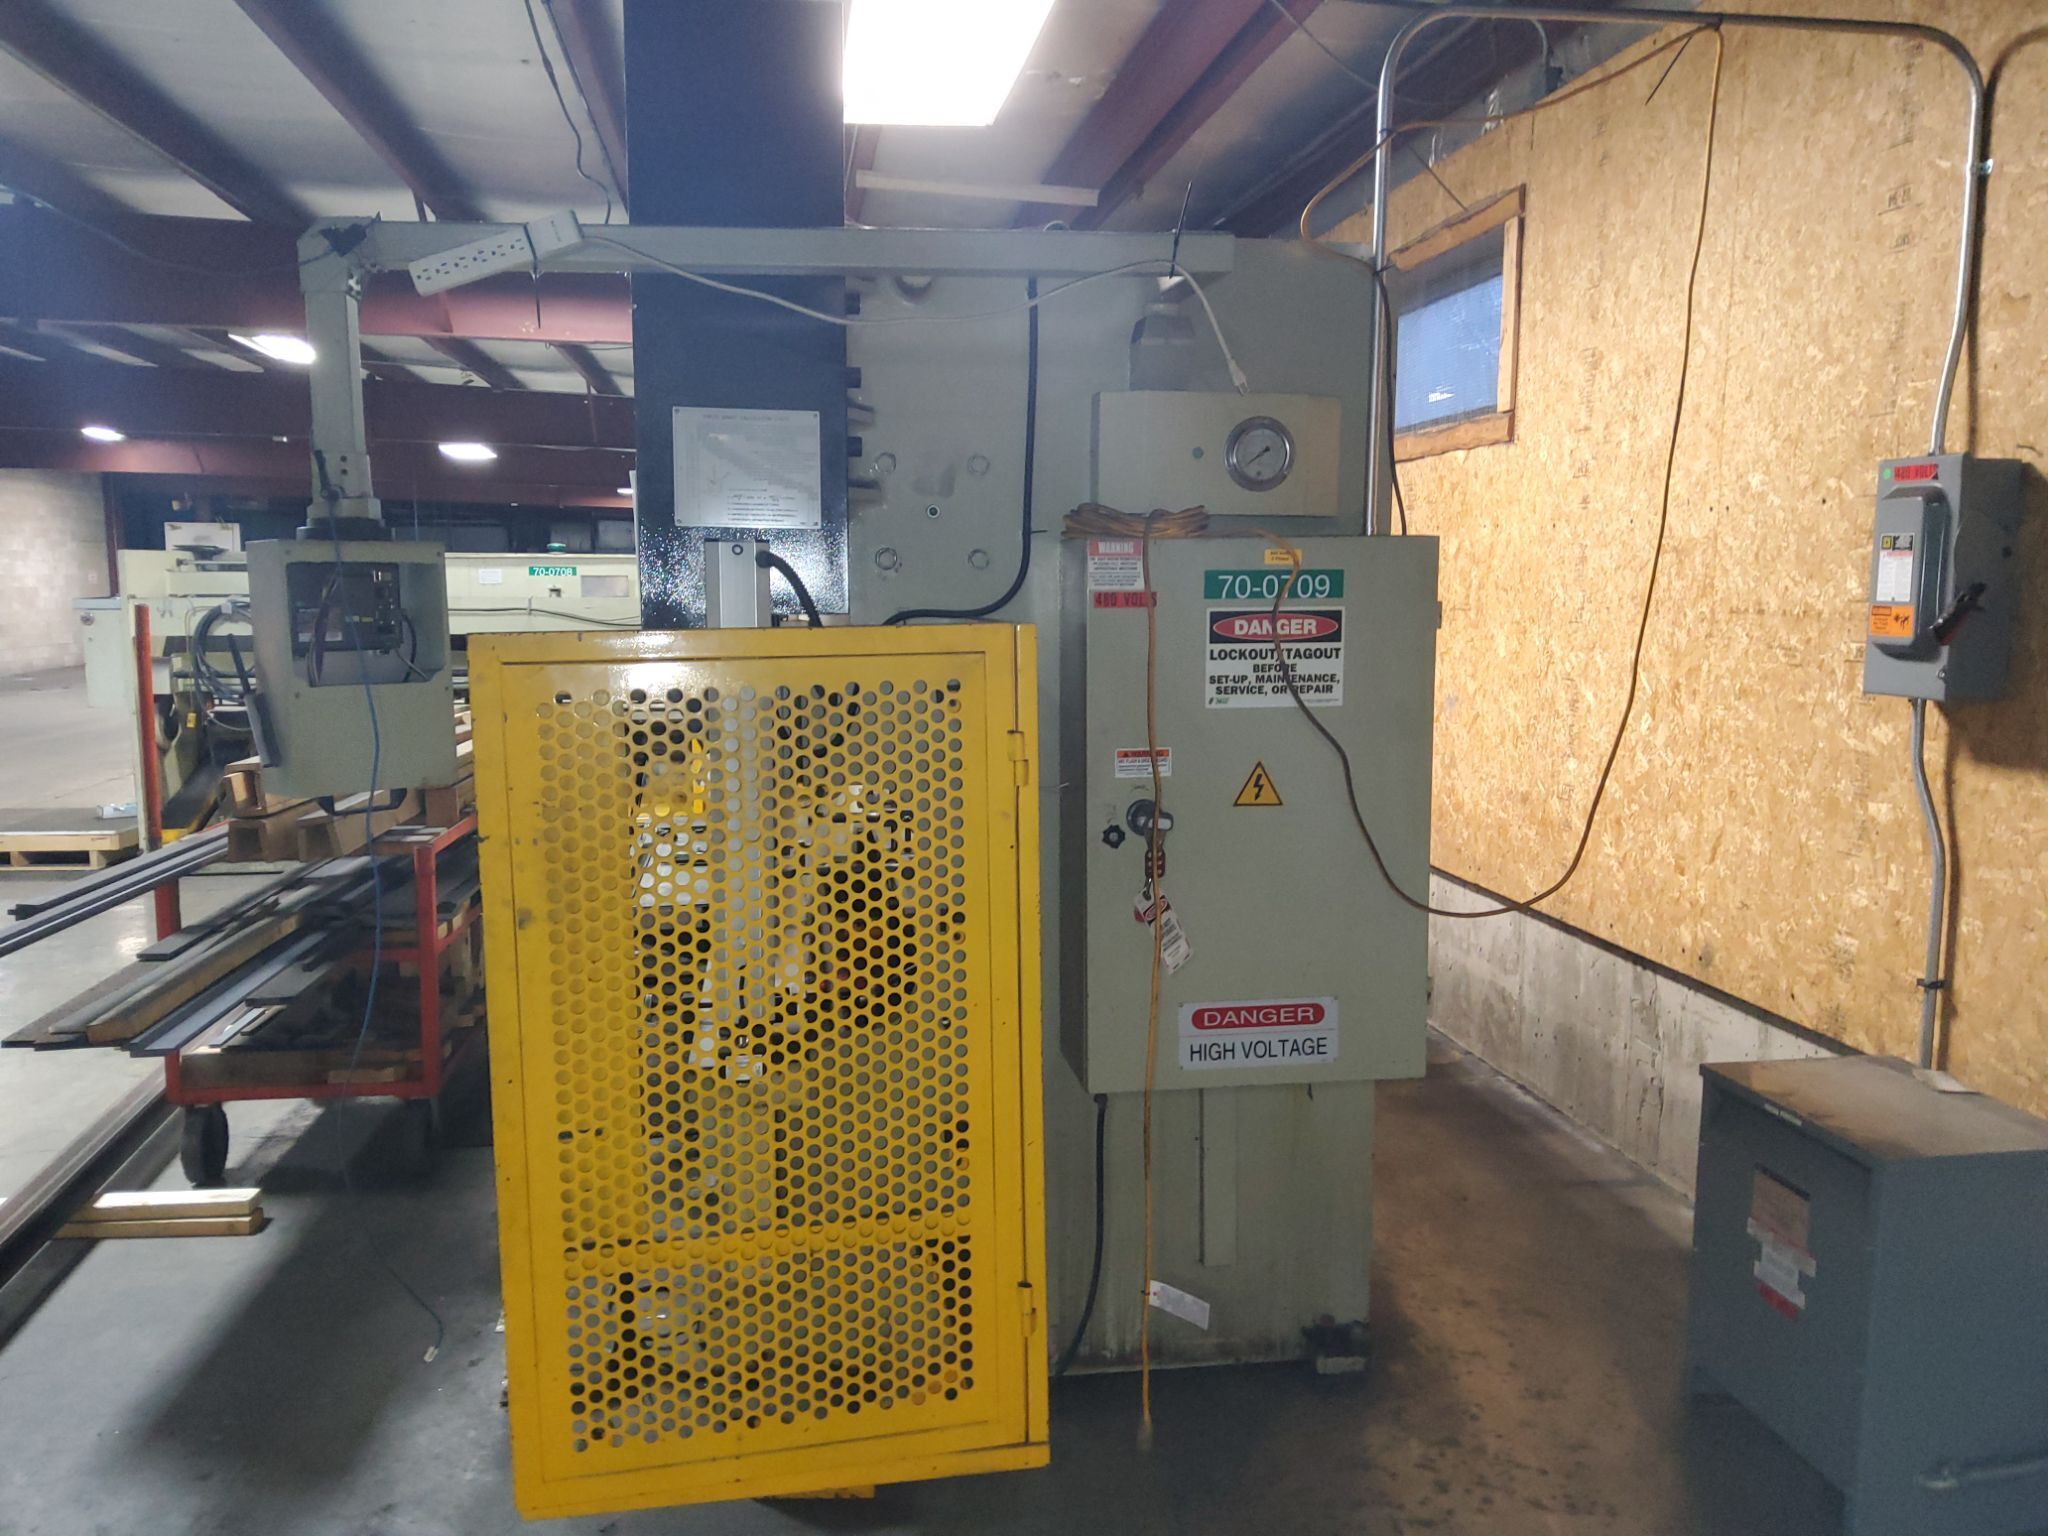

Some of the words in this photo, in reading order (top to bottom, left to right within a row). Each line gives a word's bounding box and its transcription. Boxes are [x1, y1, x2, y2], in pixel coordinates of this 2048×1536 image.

[1098, 541, 1134, 554] WARNING
[533, 567, 573, 576] 70-0708
[1123, 592, 1158, 608] VOLS
[1234, 618, 1317, 635] DANGER
[1209, 674, 1252, 685] SET-UP,
[1255, 673, 1340, 684] MAINENANCE,
[1215, 685, 1268, 696] SERVICE,
[1271, 684, 1288, 694] OR
[1203, 1006, 1314, 1027] DANGER
[1190, 1041, 1236, 1062] HIGH
[1240, 1036, 1328, 1059] VOLTAGE
